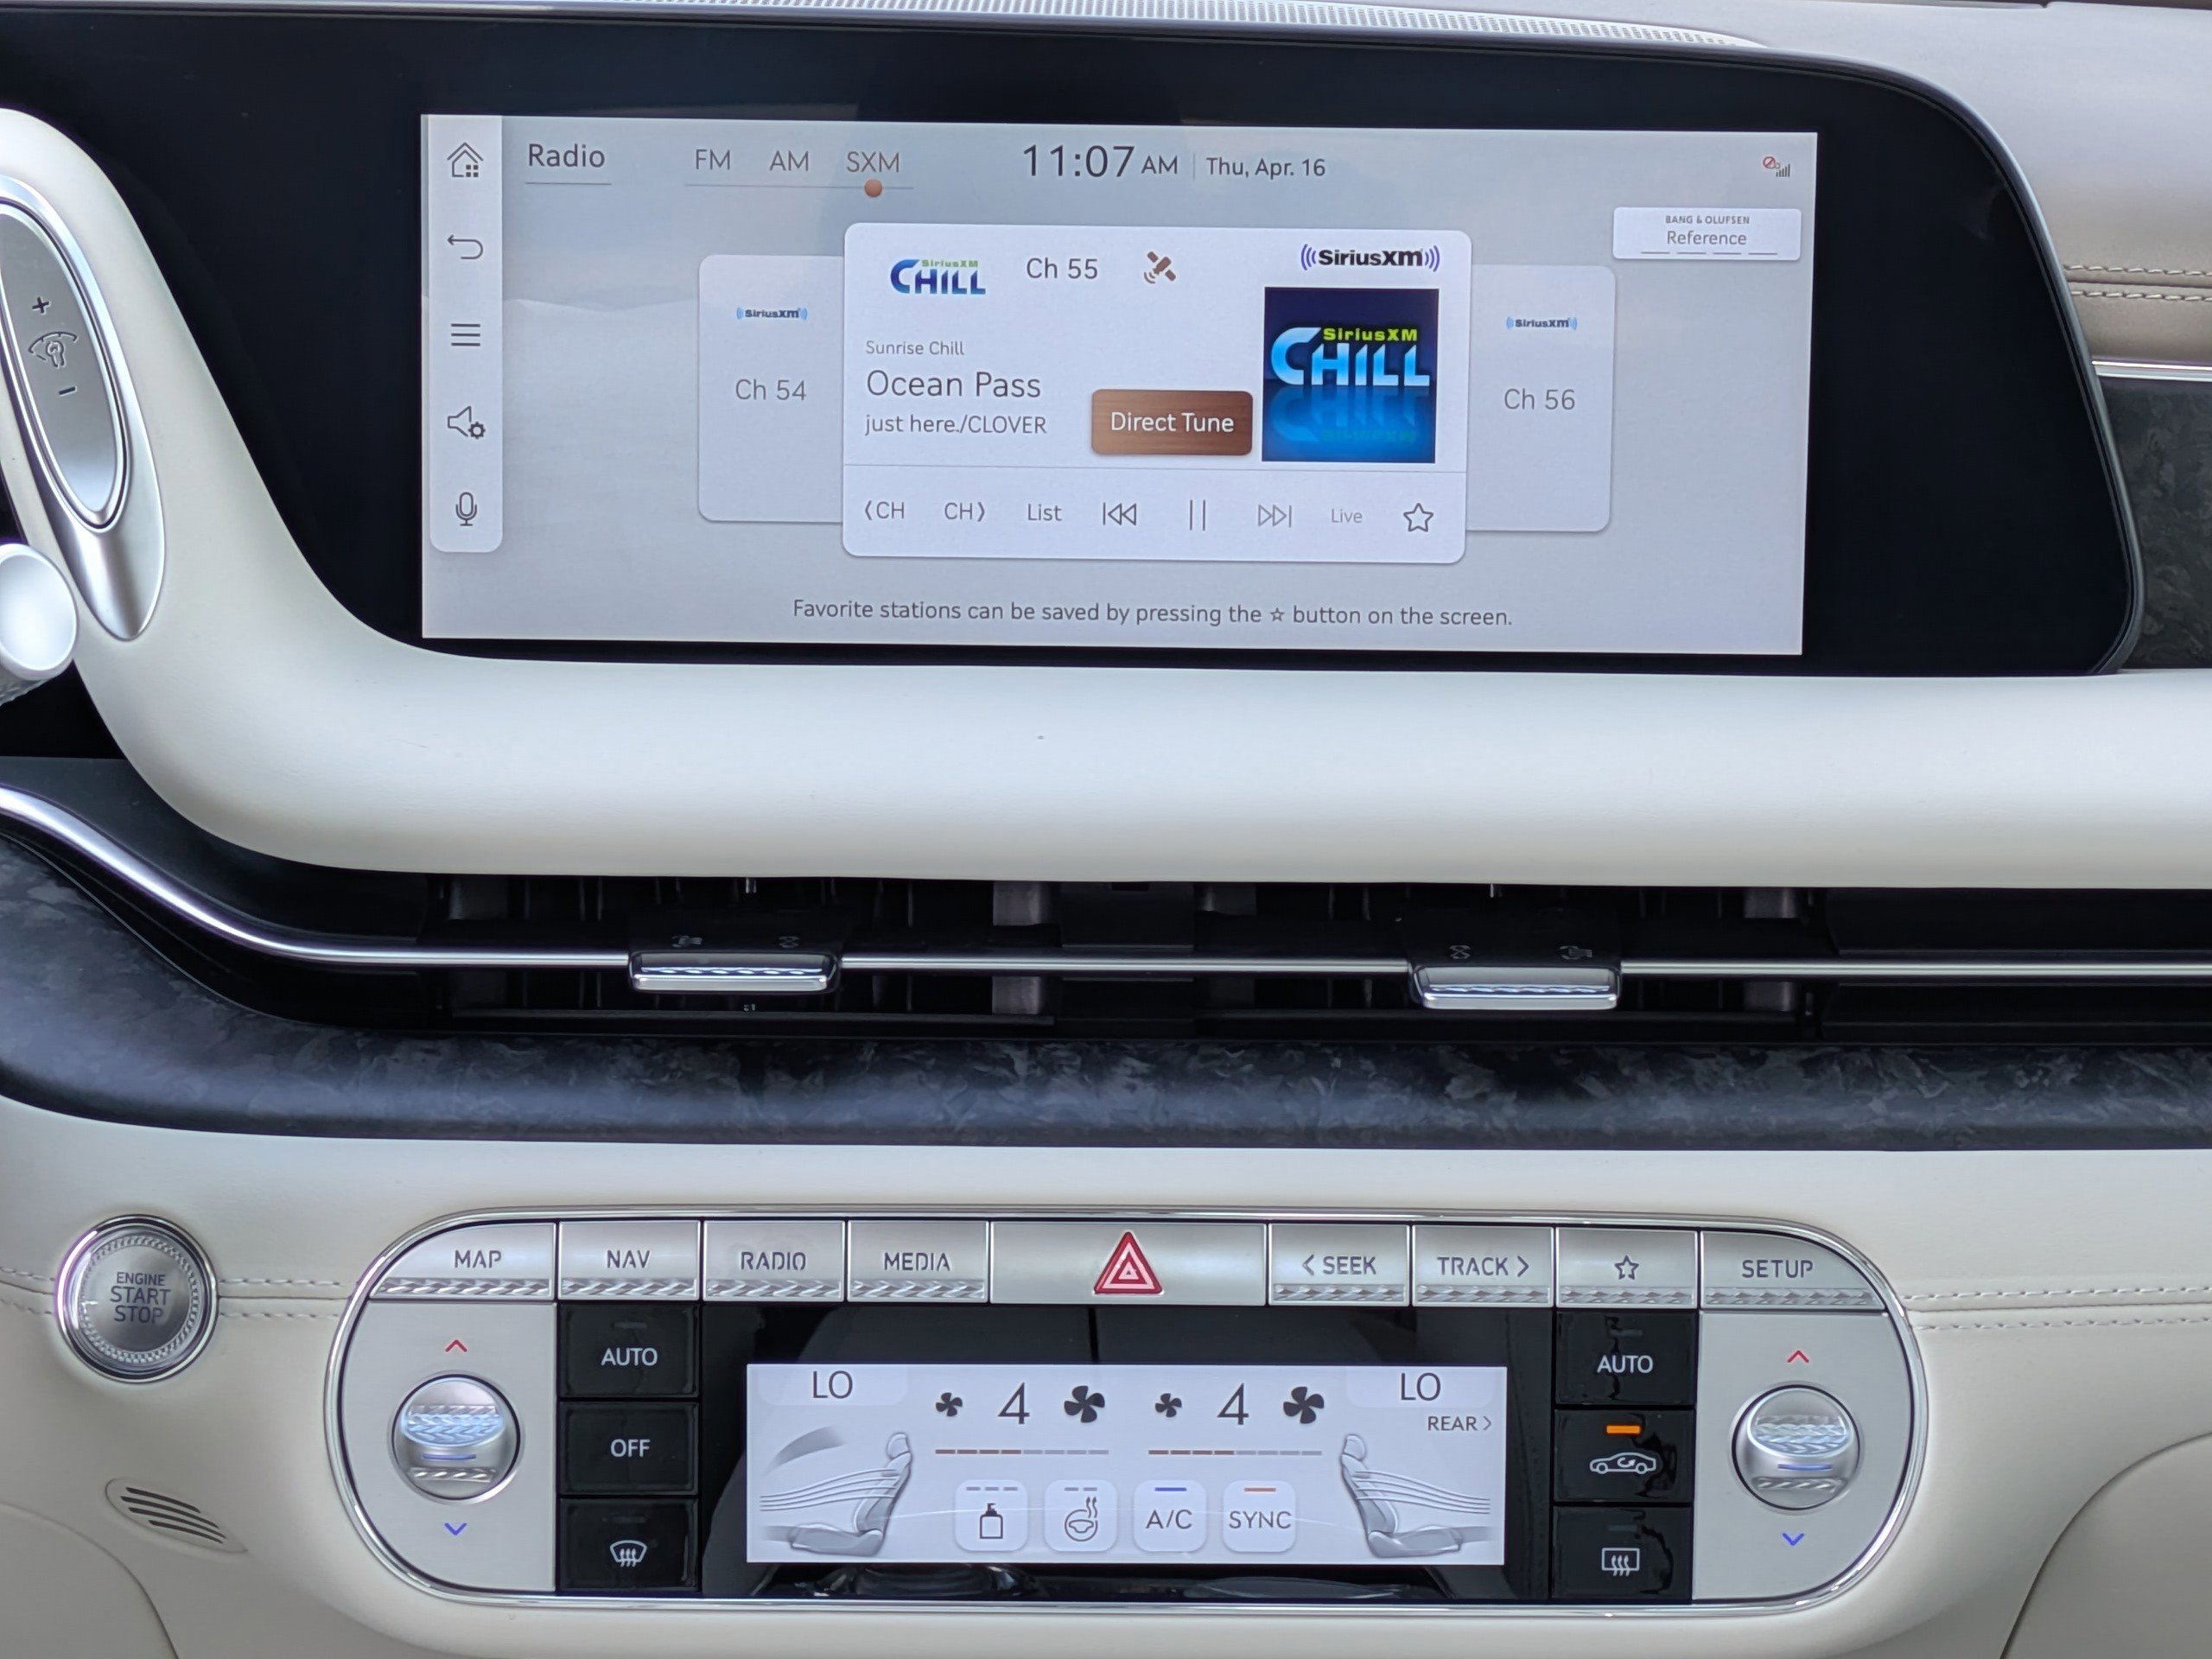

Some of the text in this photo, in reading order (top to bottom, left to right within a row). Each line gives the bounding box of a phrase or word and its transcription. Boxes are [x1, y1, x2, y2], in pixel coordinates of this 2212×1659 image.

[528, 143, 606, 168] Radio
[695, 149, 731, 171] FM
[769, 149, 810, 172] AM
[846, 150, 901, 173] SXM
[1024, 144, 1179, 178] 11:07 AM
[1206, 156, 1326, 180] Thu, Apr. 16
[1665, 215, 1751, 225] BANG & OLUFSEN
[1667, 230, 1747, 245] Reference
[890, 259, 987, 295] CHILL
[1026, 257, 1098, 280] Ch 55
[1322, 327, 1418, 341] SiriusXM
[865, 340, 965, 355] Sunrise Chill
[1270, 327, 1431, 387] CHILL
[735, 378, 807, 401] Ch 54
[867, 369, 1041, 397] Ocean Pass
[1503, 388, 1575, 410] Ch 56
[864, 414, 1047, 436] just here./CLOVER
[1110, 411, 1235, 433] Direct Tune
[1027, 503, 1063, 521] List
[1331, 508, 1363, 524] Live
[793, 600, 1513, 627] Favorite stations can be saved by pressing the button on the screen.
[454, 1249, 502, 1269] MAP
[606, 1249, 651, 1269] NAV
[740, 1250, 807, 1271] RADIO
[883, 1251, 951, 1272] MEDIA
[1322, 1255, 1376, 1275] SEEK
[1437, 1256, 1510, 1276] TRACK
[1741, 1259, 1814, 1279] SETUP
[116, 1271, 166, 1287] ENGINE
[110, 1285, 172, 1306] START
[113, 1304, 163, 1324] STOP
[601, 1347, 658, 1367] AUTO
[1596, 1355, 1654, 1374] AUTO
[810, 1370, 854, 1400] LO
[1400, 1372, 1443, 1402] LO
[998, 1382, 1031, 1426] 4
[1217, 1382, 1249, 1426] 4
[1427, 1415, 1479, 1432] REAR
[610, 1439, 651, 1458] OFF
[1146, 1508, 1193, 1531] A/C
[1228, 1509, 1293, 1532] SYNC
